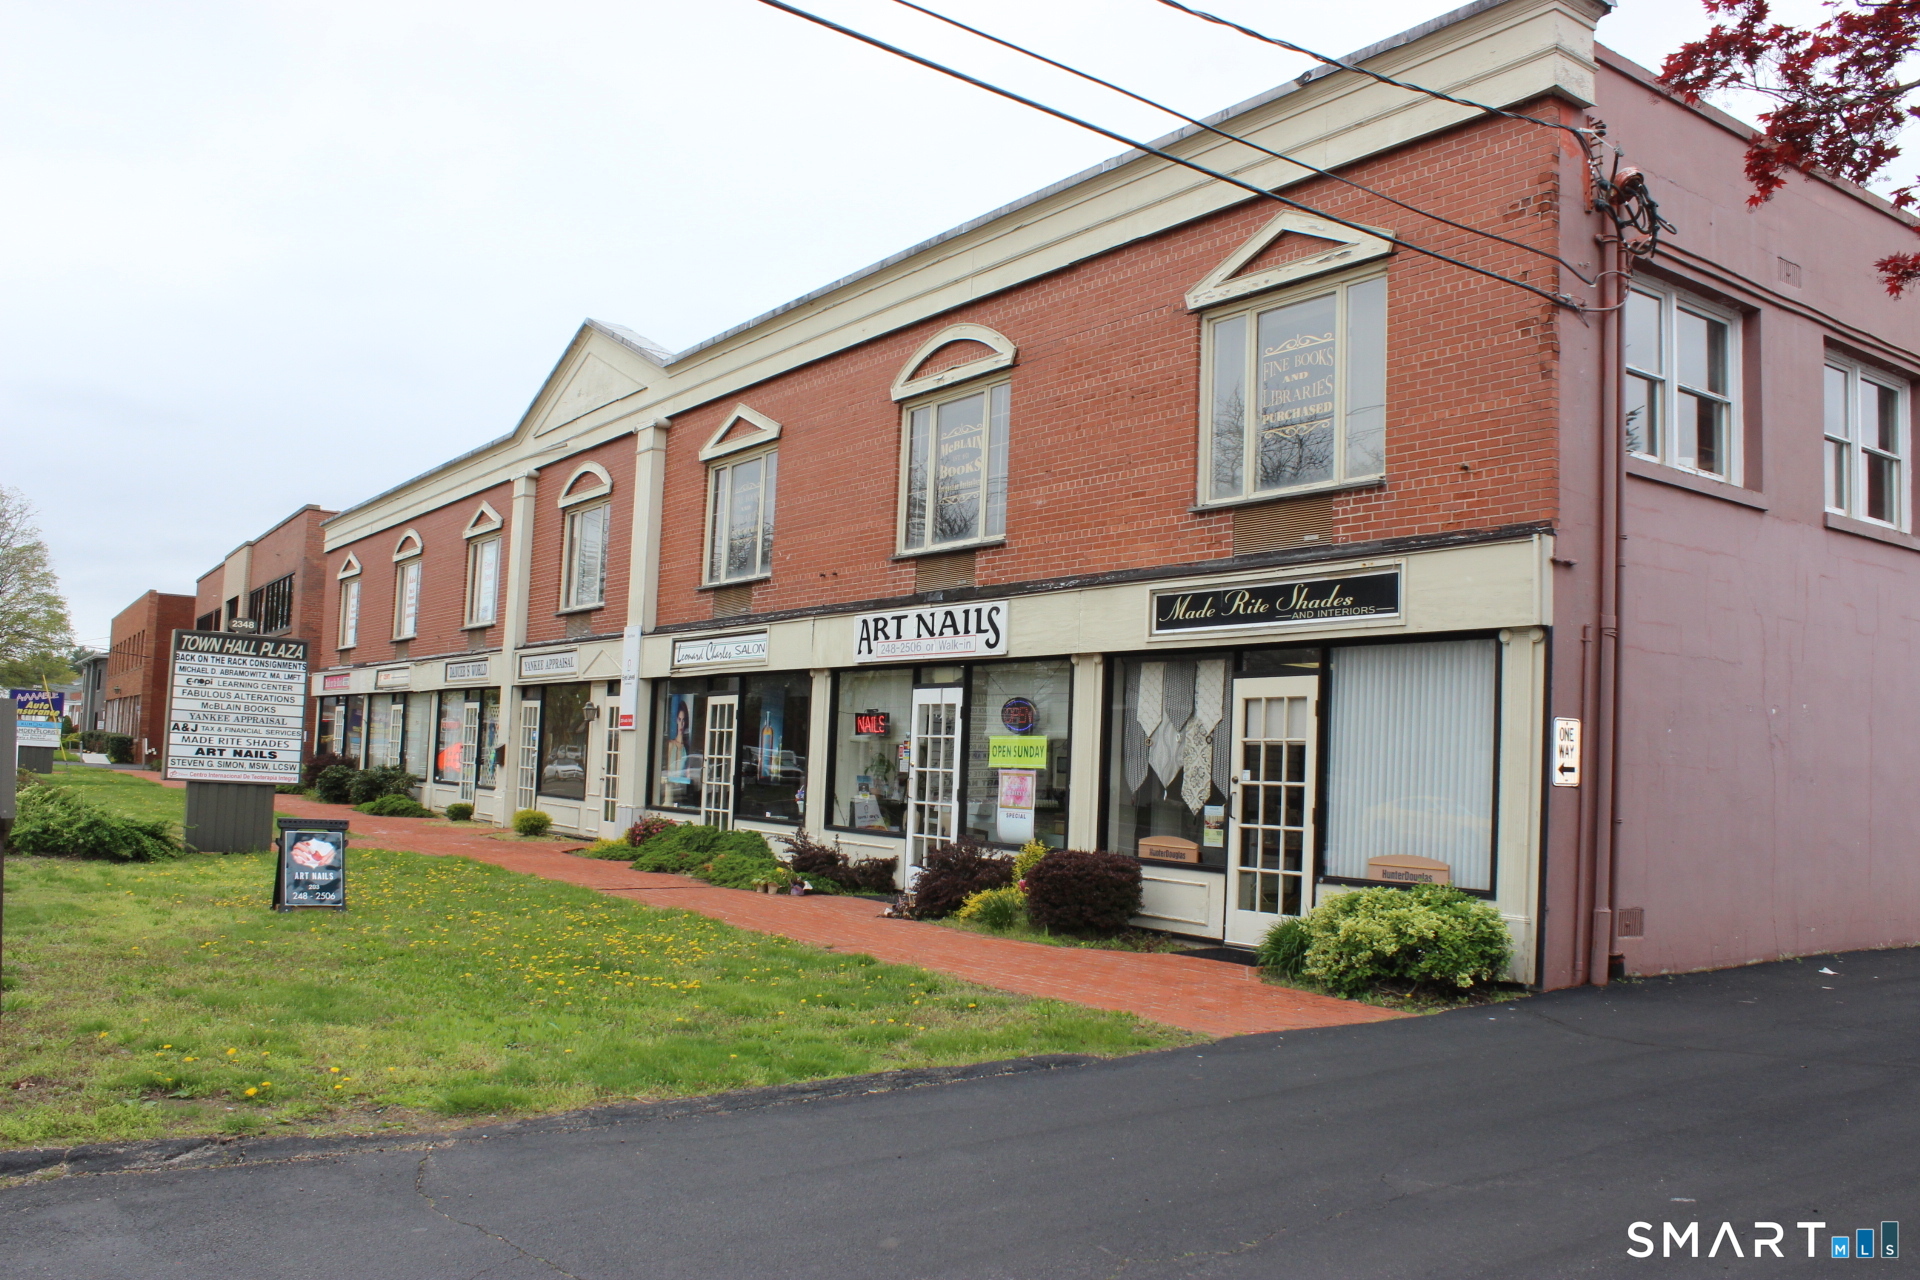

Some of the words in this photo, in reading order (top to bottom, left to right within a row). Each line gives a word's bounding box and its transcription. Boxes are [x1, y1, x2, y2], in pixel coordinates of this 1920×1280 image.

[1263, 357, 1290, 381] FINE
[1294, 346, 1334, 368] BOOKS
[1281, 371, 1309, 383] AND
[1262, 374, 1333, 408] LIBRARIES
[1262, 401, 1333, 424] PURCHASED
[939, 456, 982, 480] BOOKS
[1159, 594, 1216, 622] Made
[1221, 589, 1270, 616] Rite
[1276, 583, 1354, 612] Shades
[1291, 610, 1314, 620] AND
[1317, 606, 1376, 618] INTERIORS
[231, 619, 255, 629] 2348
[857, 614, 908, 655] ART
[915, 606, 1000, 649] NAILS
[181, 634, 223, 653] TOWN
[222, 639, 257, 656] HALL
[260, 641, 305, 660] PLAZA
[677, 643, 704, 663] Leonard
[705, 641, 732, 661] Charles
[734, 643, 766, 656] SALON
[880, 641, 922, 655] 248-2506
[926, 643, 934, 652] or
[938, 639, 972, 651] Walk-in
[176, 652, 197, 662] BACK
[198, 655, 208, 664] ON
[210, 656, 226, 665] THE
[227, 657, 248, 667] RACK
[249, 659, 307, 671] CONSIGNMENTS
[524, 659, 544, 672] YANKEE
[545, 656, 575, 670] APPRAISAL
[178, 665, 209, 675] MICHAEL
[283, 673, 301, 681] LMFT
[217, 680, 259, 690] LEARNING
[260, 682, 293, 692] CENTER
[181, 689, 233, 699] FABULOUS
[233, 691, 296, 704] ALTERATIONS
[16, 708, 60, 717] nsurance
[25, 701, 50, 710] Auto
[201, 702, 242, 711] McBLAIN
[243, 704, 277, 714] BOOKS
[189, 712, 231, 723] YANKEE
[233, 715, 288, 726] APPRAISAL
[857, 715, 885, 733] NAILS
[171, 722, 199, 732] A&J
[224, 726, 263, 735] FINANCIAL
[265, 728, 302, 737] SERVICES
[1559, 726, 1575, 742] ONE
[181, 735, 215, 745] MADE
[218, 737, 242, 746] RITE
[246, 738, 290, 748] SHADES
[194, 747, 227, 757] ART
[233, 749, 278, 759] NAILS
[992, 745, 1012, 758] OPEN
[1013, 745, 1045, 759] SUNDAY
[1558, 744, 1575, 759] WAY
[170, 758, 205, 767] STEVEN
[206, 760, 215, 768] G.
[217, 760, 247, 770] SIMON,
[248, 762, 271, 771] MSW,
[272, 763, 298, 772] LCSW
[1006, 812, 1027, 820] SPECIAL
[294, 871, 310, 880] ART
[312, 871, 334, 880] NAILS
[292, 891, 308, 900] 248
[315, 891, 336, 900] 2506
